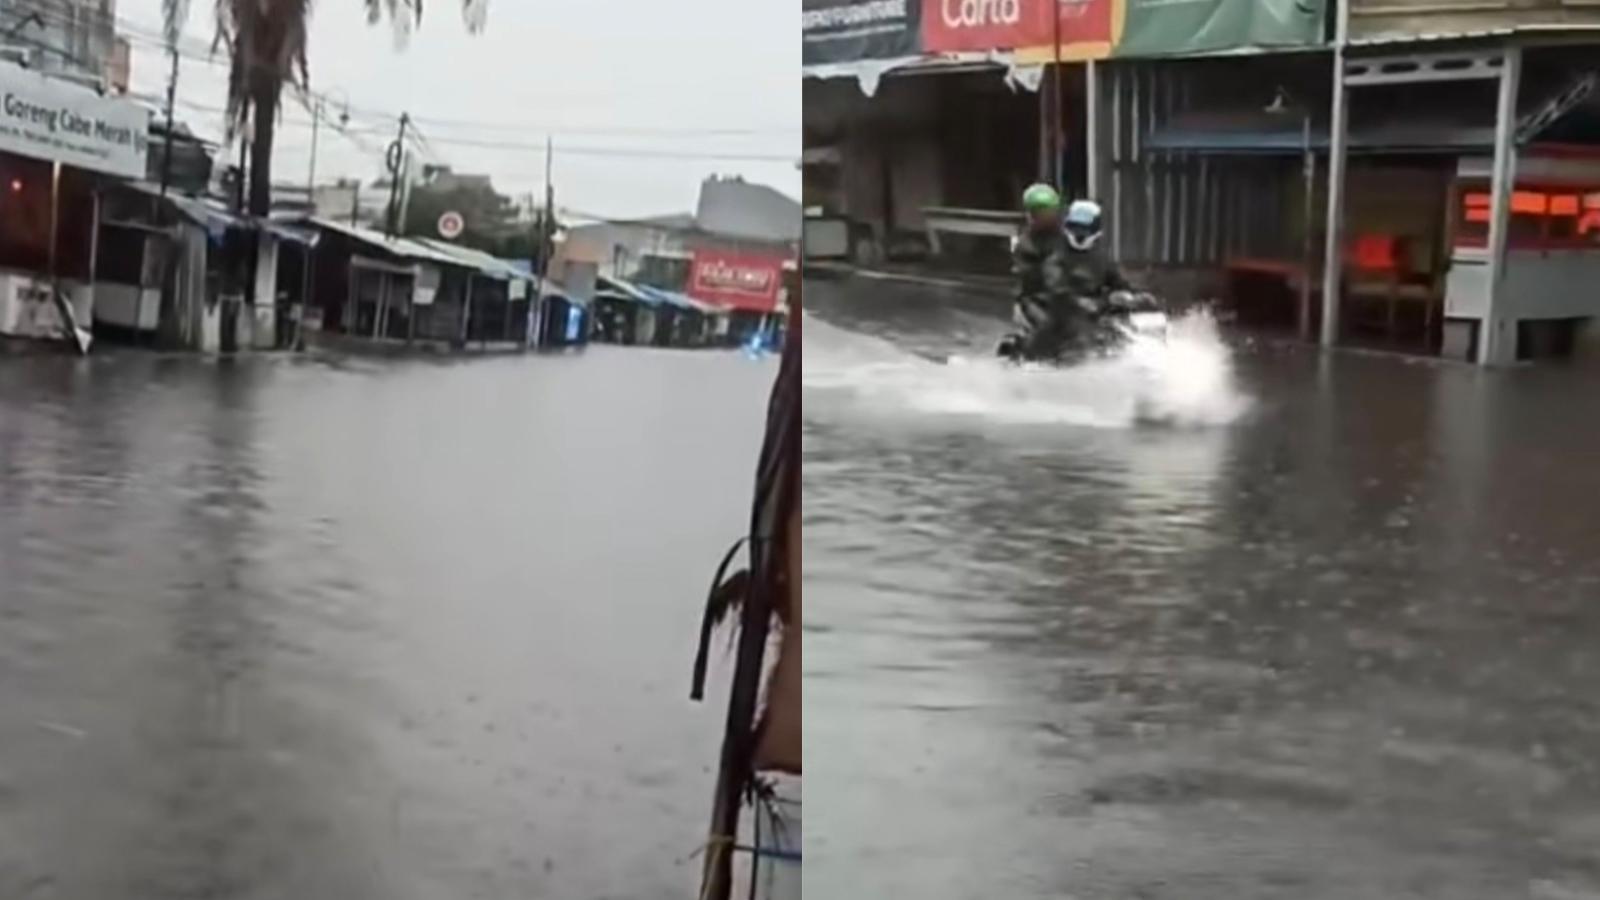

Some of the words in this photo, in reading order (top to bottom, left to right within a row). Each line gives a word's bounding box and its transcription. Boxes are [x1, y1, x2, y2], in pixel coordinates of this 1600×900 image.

[4, 92, 58, 133] Goreng
[60, 108, 92, 137] Cabe
[94, 118, 132, 145] Merah
